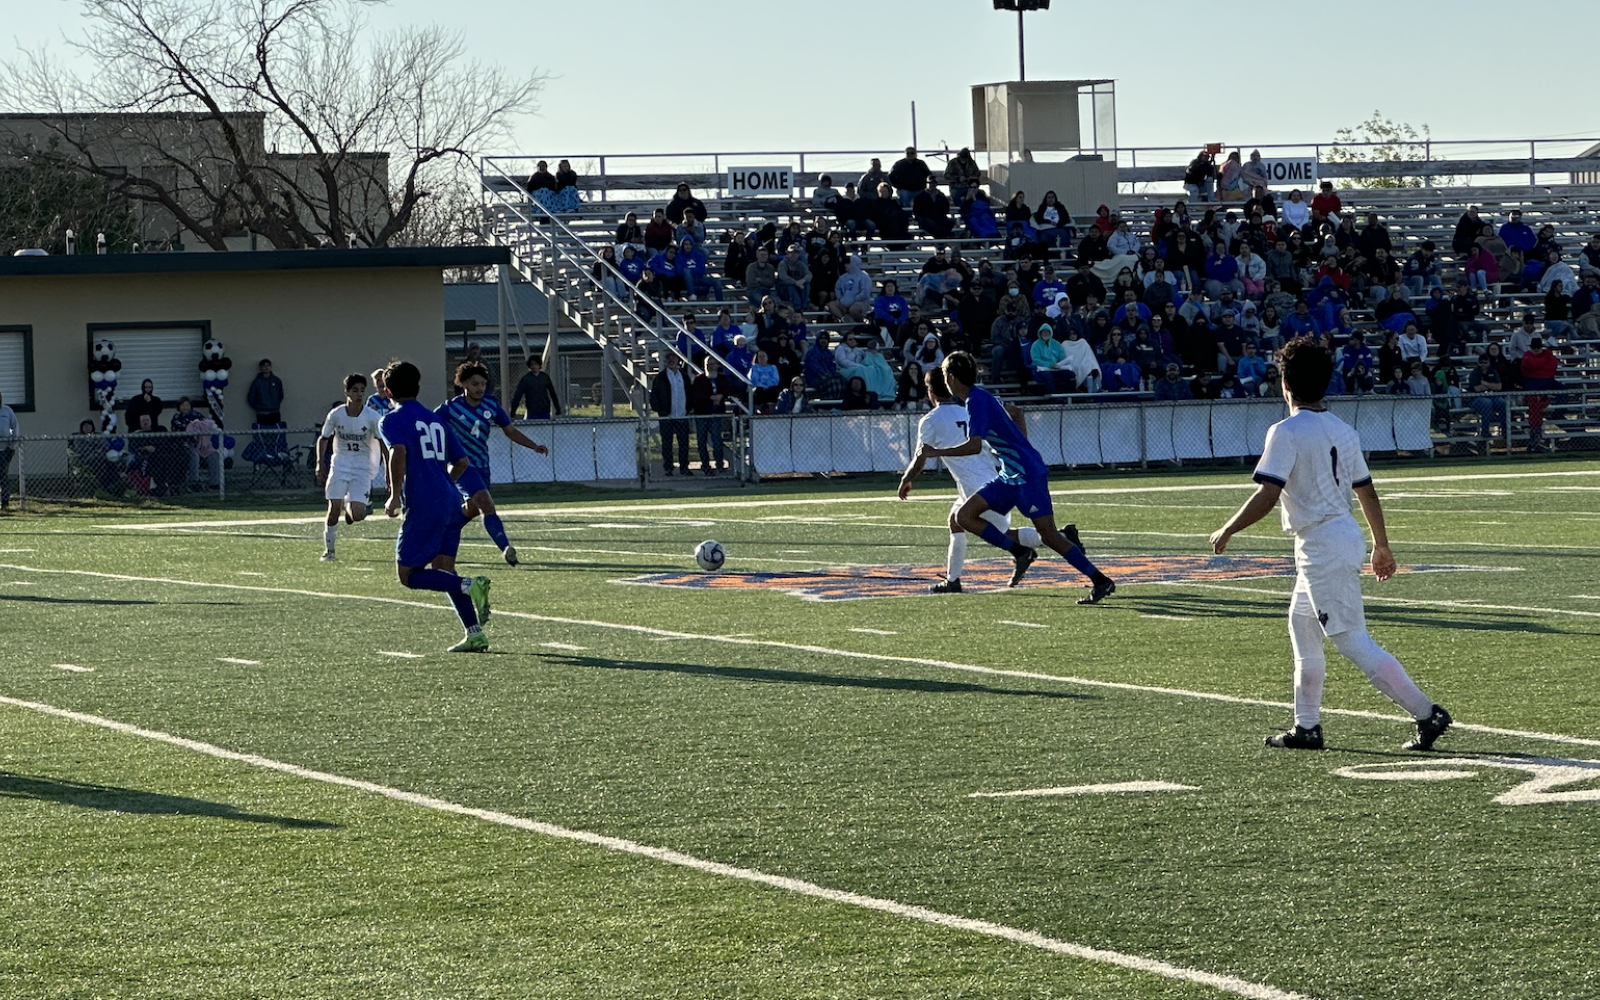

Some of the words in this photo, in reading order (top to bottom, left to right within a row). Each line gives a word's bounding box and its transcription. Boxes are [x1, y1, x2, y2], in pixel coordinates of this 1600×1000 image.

[733, 171, 788, 190] HOME
[470, 419, 480, 439] 4
[347, 443, 361, 452] 13
[415, 420, 446, 461] 20
[1330, 446, 1340, 487] 1
